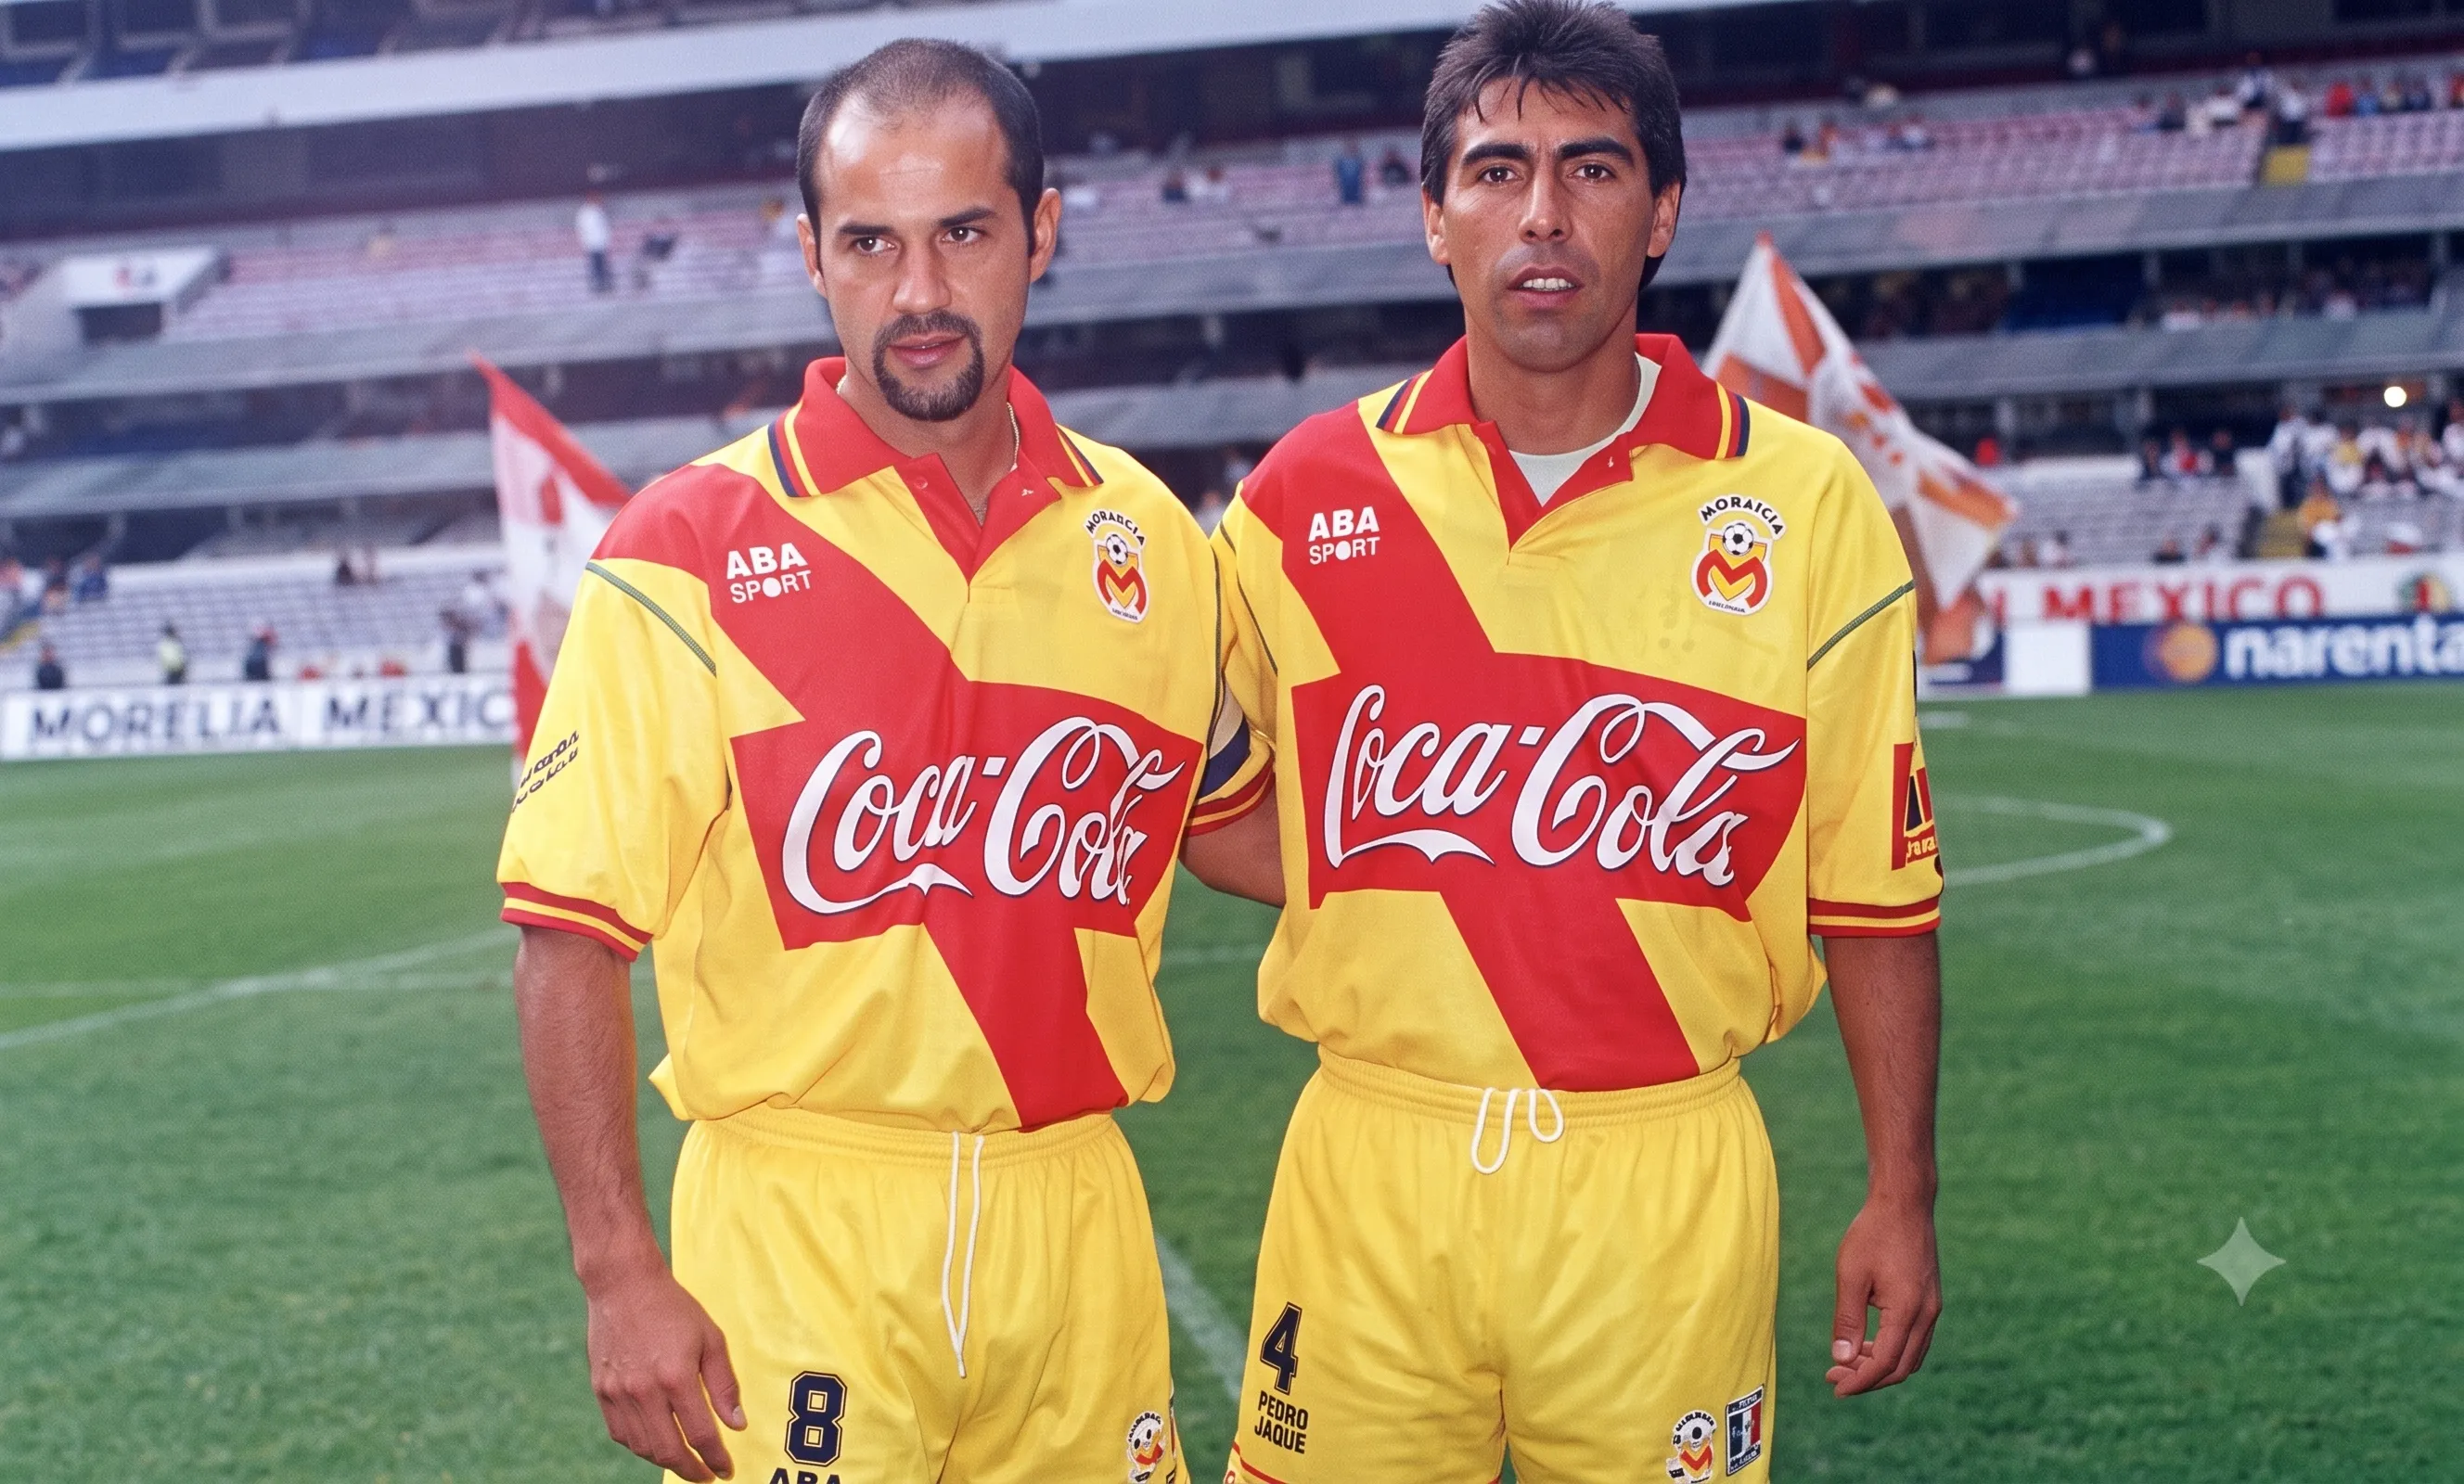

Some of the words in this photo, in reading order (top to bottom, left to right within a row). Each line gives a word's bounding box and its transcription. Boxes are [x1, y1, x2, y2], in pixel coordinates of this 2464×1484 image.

[1308, 505, 1380, 543] ABA
[1700, 496, 1783, 535] MORAICIA
[726, 543, 809, 580] ABA
[1309, 536, 1380, 566] SPORT
[729, 569, 812, 604] SPORT
[2043, 576, 2326, 622] MEXICO
[33, 697, 282, 740] MORELIA
[1324, 684, 1801, 887] Coca-Cola
[782, 715, 1186, 915] Coca-Cola
[1260, 1301, 1303, 1396] 4
[784, 1370, 848, 1467] 8
[1258, 1390, 1309, 1430] PEDRO
[1254, 1415, 1307, 1454] JAQUE
